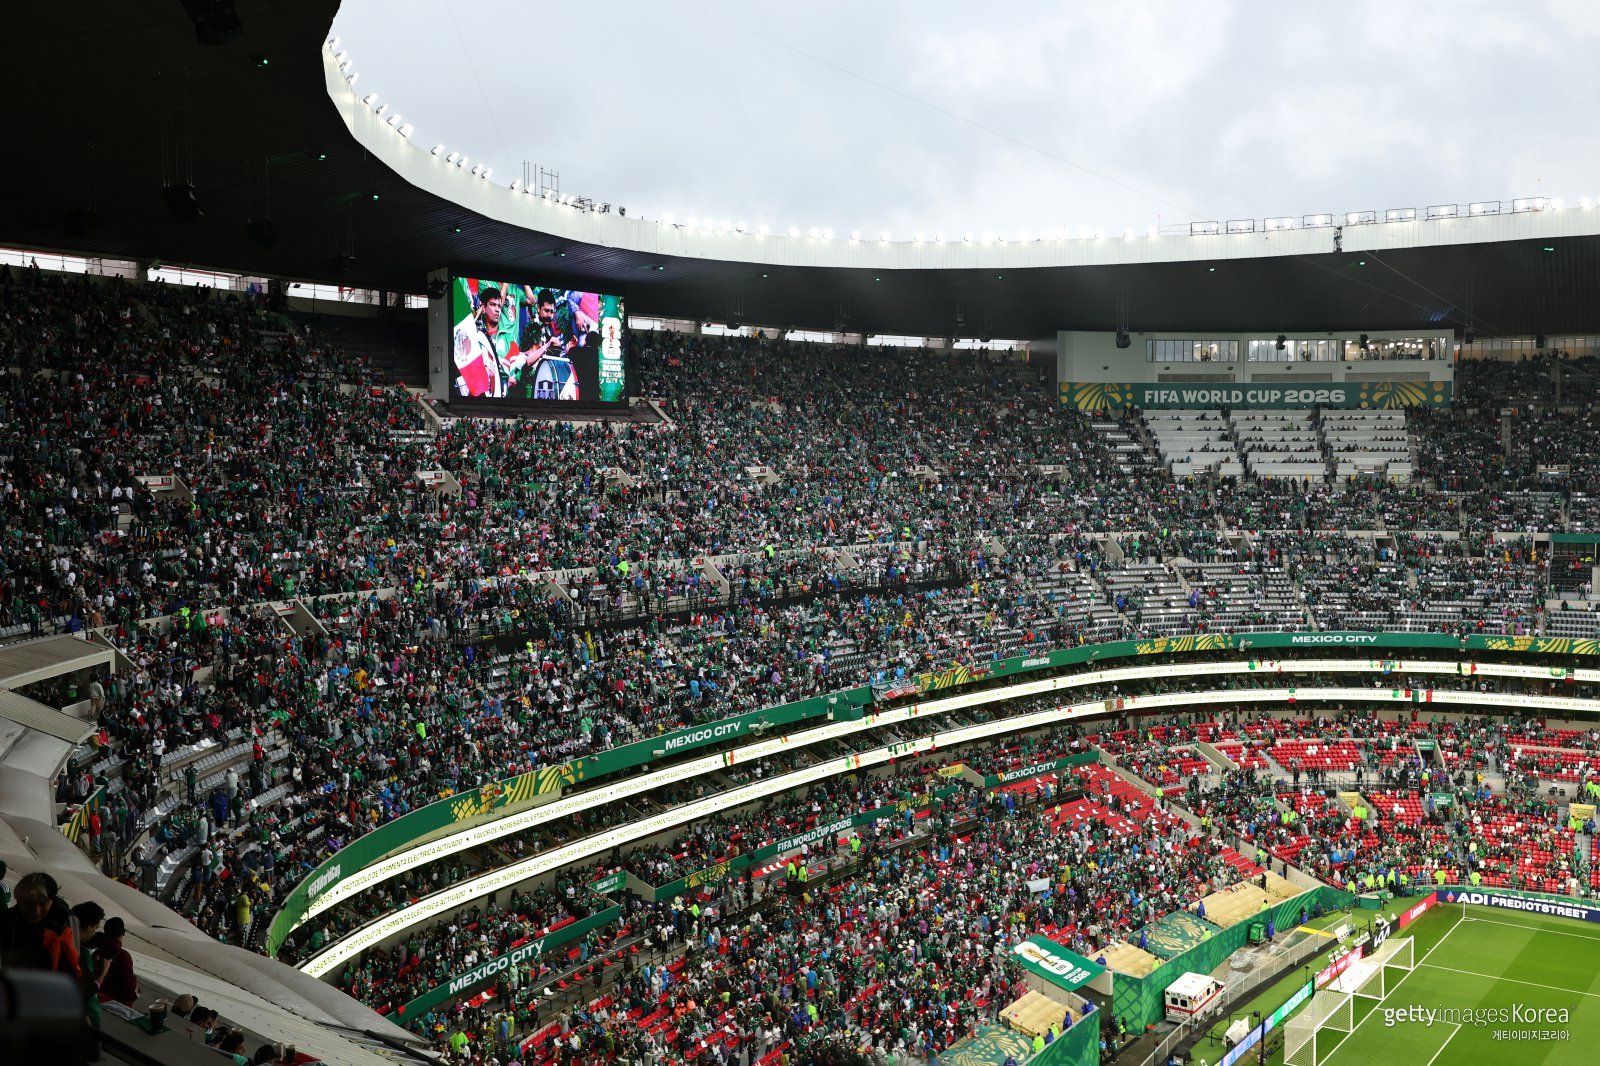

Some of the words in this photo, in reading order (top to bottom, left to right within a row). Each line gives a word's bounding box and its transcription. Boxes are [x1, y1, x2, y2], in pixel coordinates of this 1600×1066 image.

[1144, 390, 1180, 403] FIFA
[1182, 390, 1243, 403] WORLD
[1246, 390, 1281, 403] CUP
[1284, 389, 1346, 403] 2026
[1292, 635, 1343, 643] MEXICO
[1345, 635, 1378, 643] CITY
[665, 729, 712, 750] MEXICO
[714, 721, 741, 736] CITY
[1002, 768, 1036, 781] MEXICO
[1036, 761, 1057, 773] CITY
[777, 841, 792, 852] FIFA
[792, 831, 816, 848] WORLD
[816, 826, 830, 838] CUP
[829, 818, 852, 832] 2026
[1410, 902, 1427, 920] Lenovo
[1456, 892, 1488, 905] ADI
[1491, 896, 1588, 919] PREDICTSTREET
[449, 957, 508, 995] MEXICO
[511, 939, 545, 963] CITY
